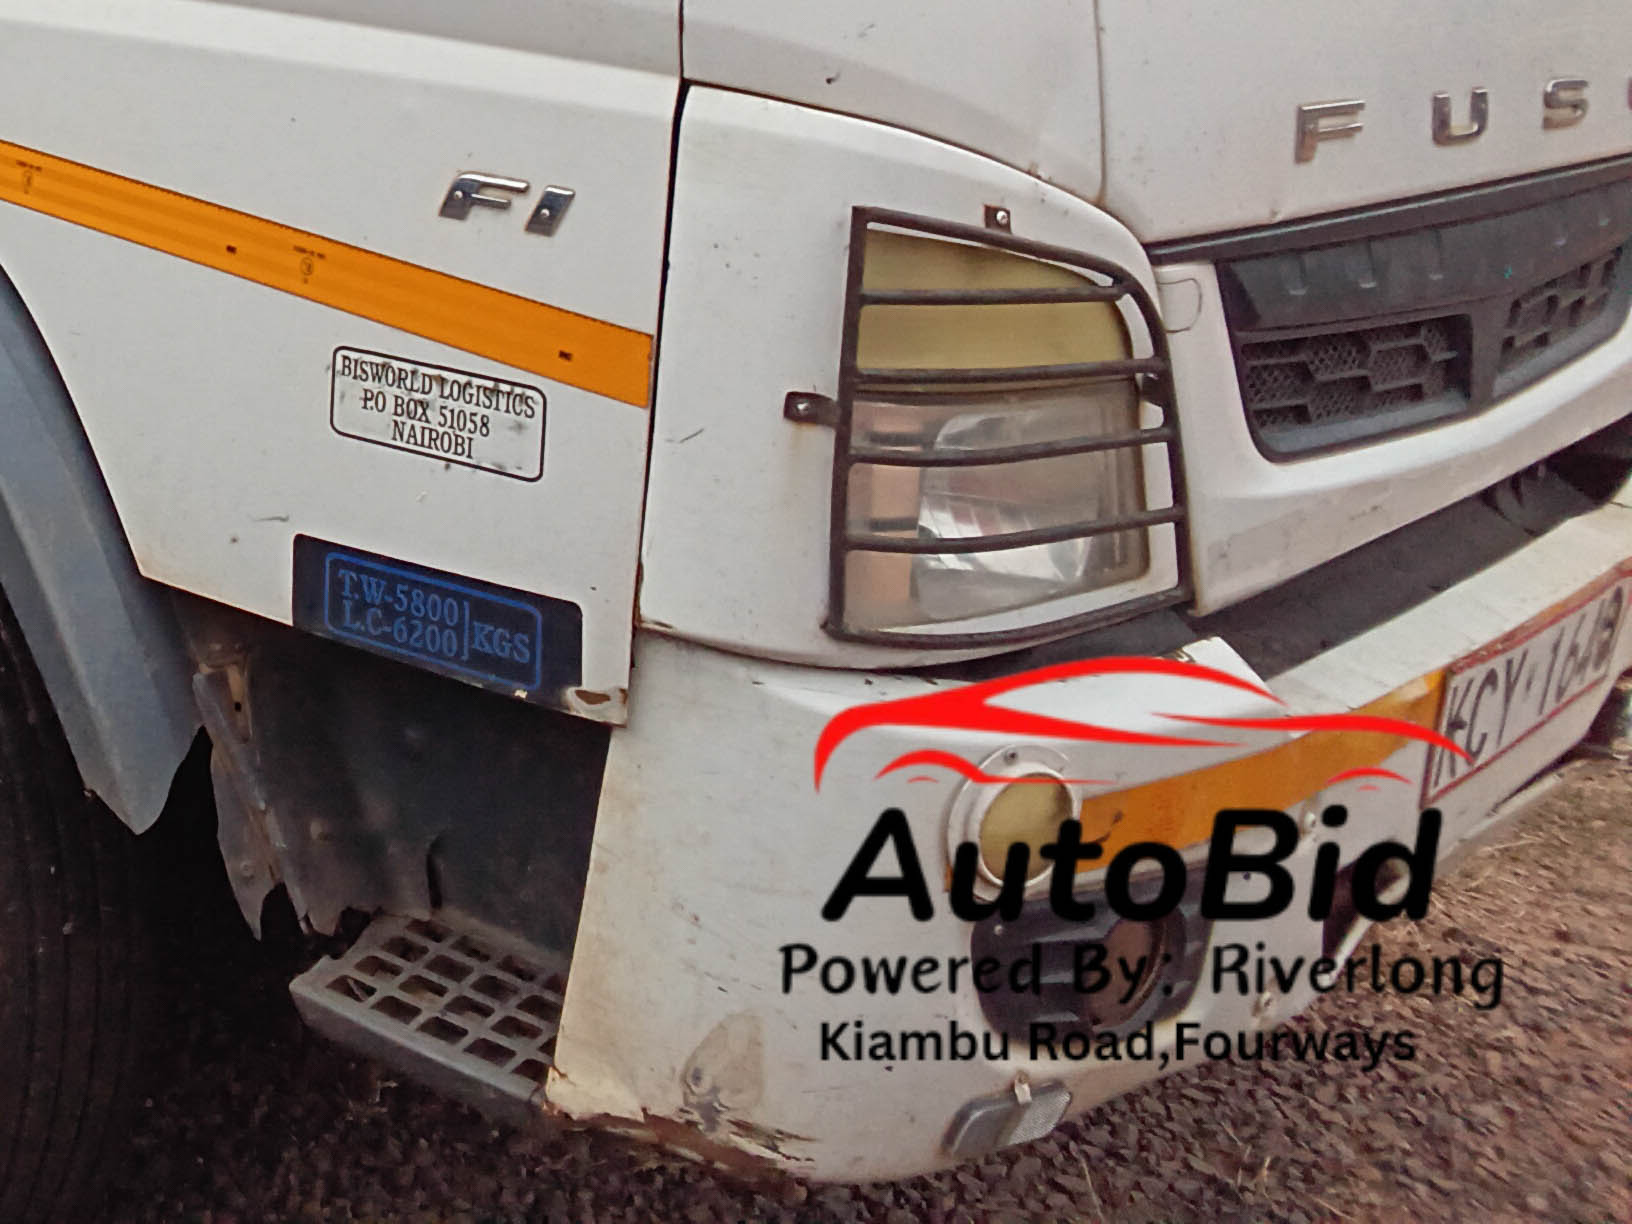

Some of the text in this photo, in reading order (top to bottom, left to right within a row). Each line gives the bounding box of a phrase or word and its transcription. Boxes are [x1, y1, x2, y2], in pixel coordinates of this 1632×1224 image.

[1293, 77, 1632, 165] FUS
[340, 355, 536, 419] BISWORLD LOGISTICS
[392, 395, 431, 424] BOX
[438, 405, 490, 438] 51058
[391, 419, 474, 460] NAIROBI
[471, 619, 531, 664] KGS
